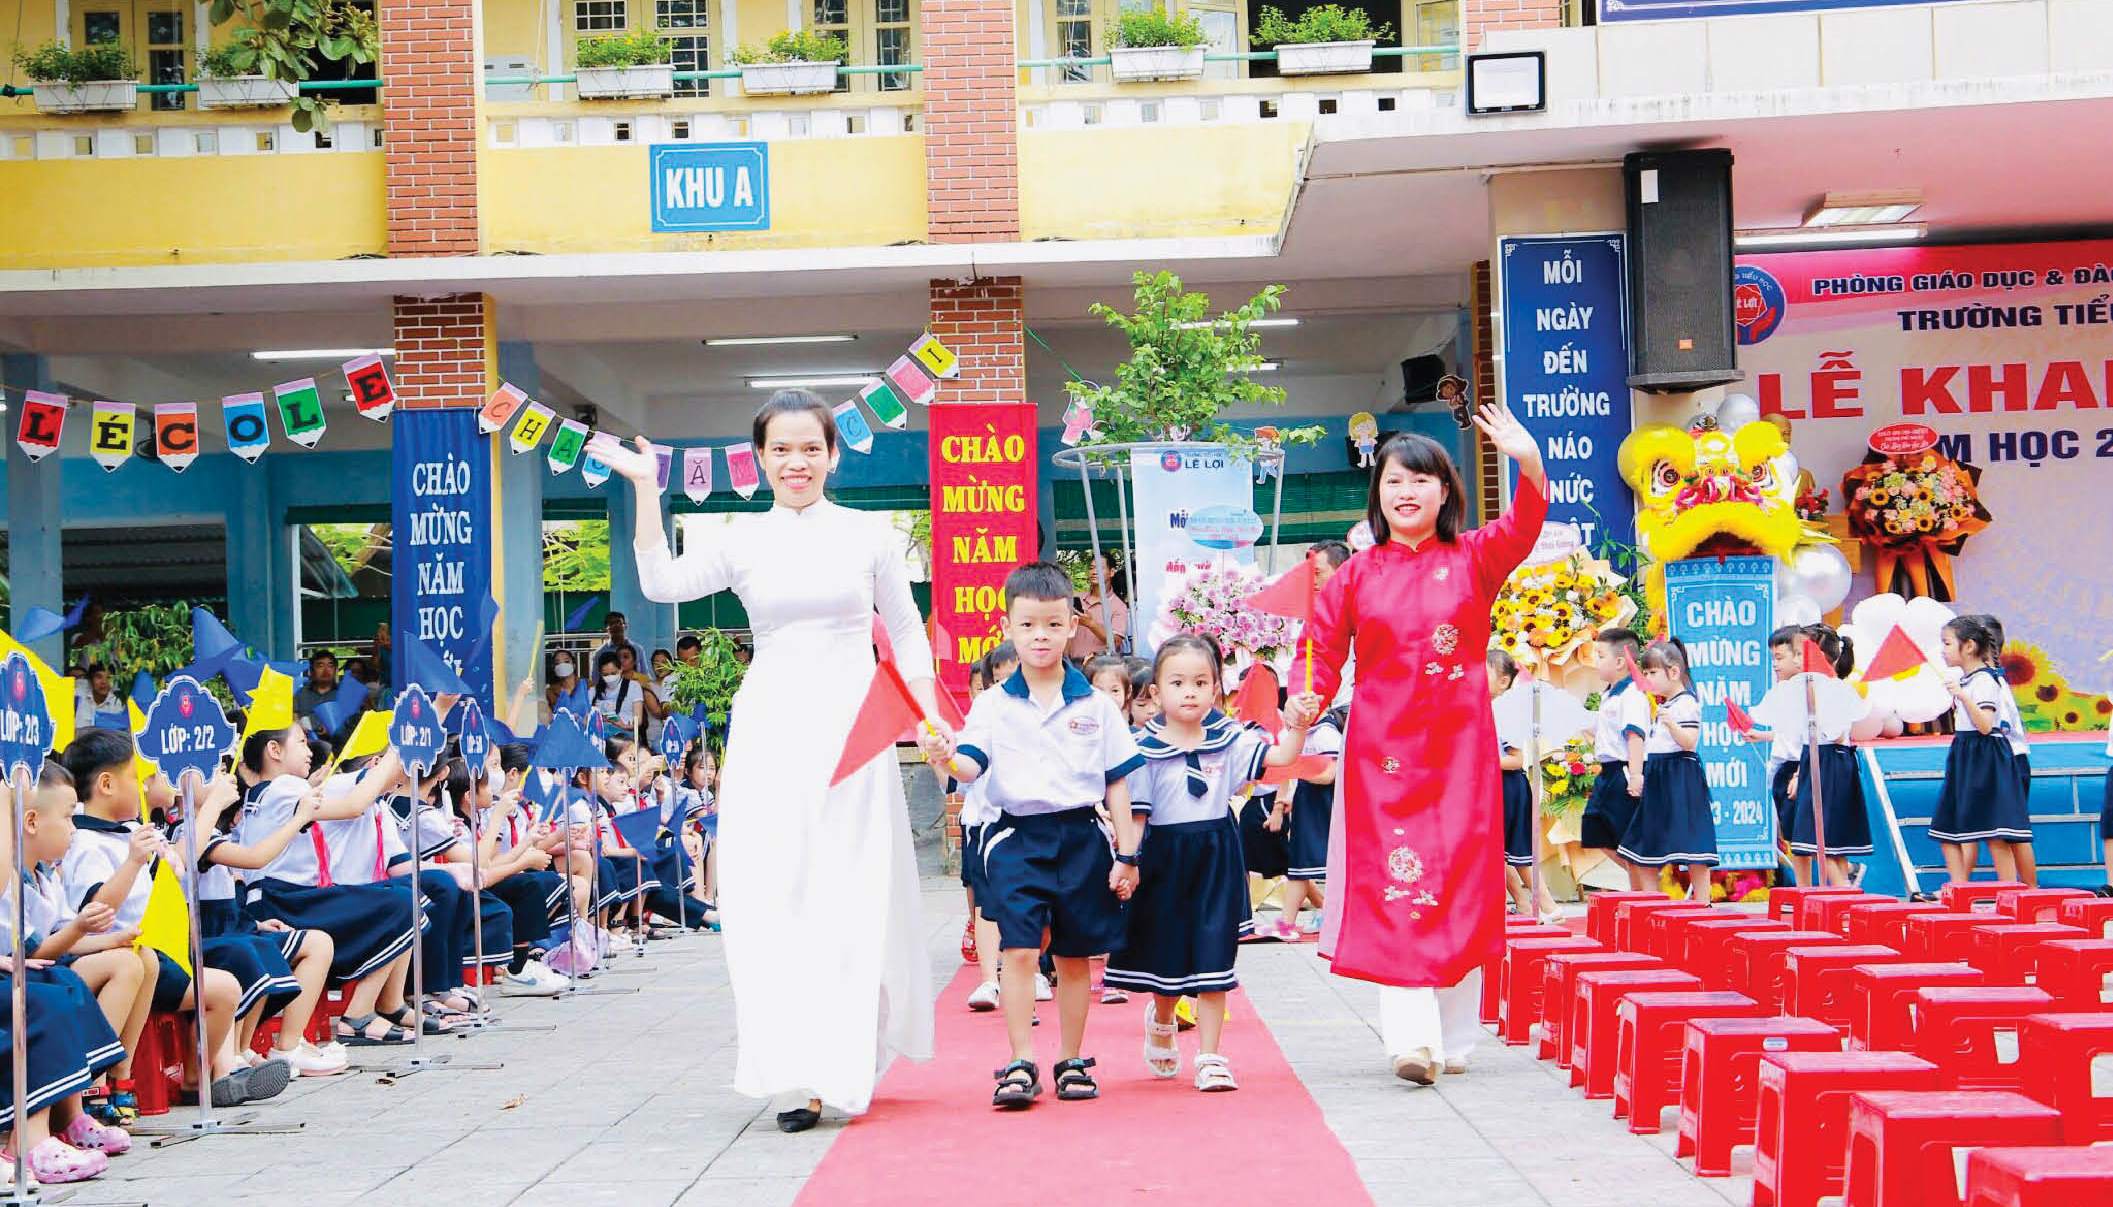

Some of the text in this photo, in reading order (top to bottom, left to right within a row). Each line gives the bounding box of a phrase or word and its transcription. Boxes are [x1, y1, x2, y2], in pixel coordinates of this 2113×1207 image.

[666, 166, 754, 209] KHU A
[1543, 249, 1583, 285] MỖI
[1813, 264, 2113, 295] PHÒNG GIÁO DỤC & ĐÀ
[1536, 301, 1593, 331] NGÀY
[1897, 293, 2113, 331] TRƯỜNG TIỂ
[1543, 341, 1587, 374] ĐẾN
[1522, 385, 1610, 417] TRƯỜNG
[1758, 351, 1863, 419] LỄ
[941, 423, 1025, 463] CHÀO
[1548, 431, 1593, 459] NÁO
[1989, 429, 2080, 468] HỌC
[412, 452, 471, 497] CHÀO
[1549, 472, 1594, 503] NỨC
[942, 474, 1025, 512] MỪNG
[410, 502, 472, 546] MỪNG
[952, 527, 1018, 564] NĂM
[417, 553, 465, 595] NĂM
[418, 606, 464, 647] HỌC
[1686, 595, 1756, 628] CHÀO
[958, 624, 1003, 664] MỚ
[1683, 635, 1760, 668] MỪNG
[1695, 675, 1751, 707] NĂM
[24, 713, 40, 747] 2/3
[160, 722, 216, 755] LỚP: 2/2
[1705, 756, 1747, 789] MỚI
[1732, 799, 1763, 825] 2024
